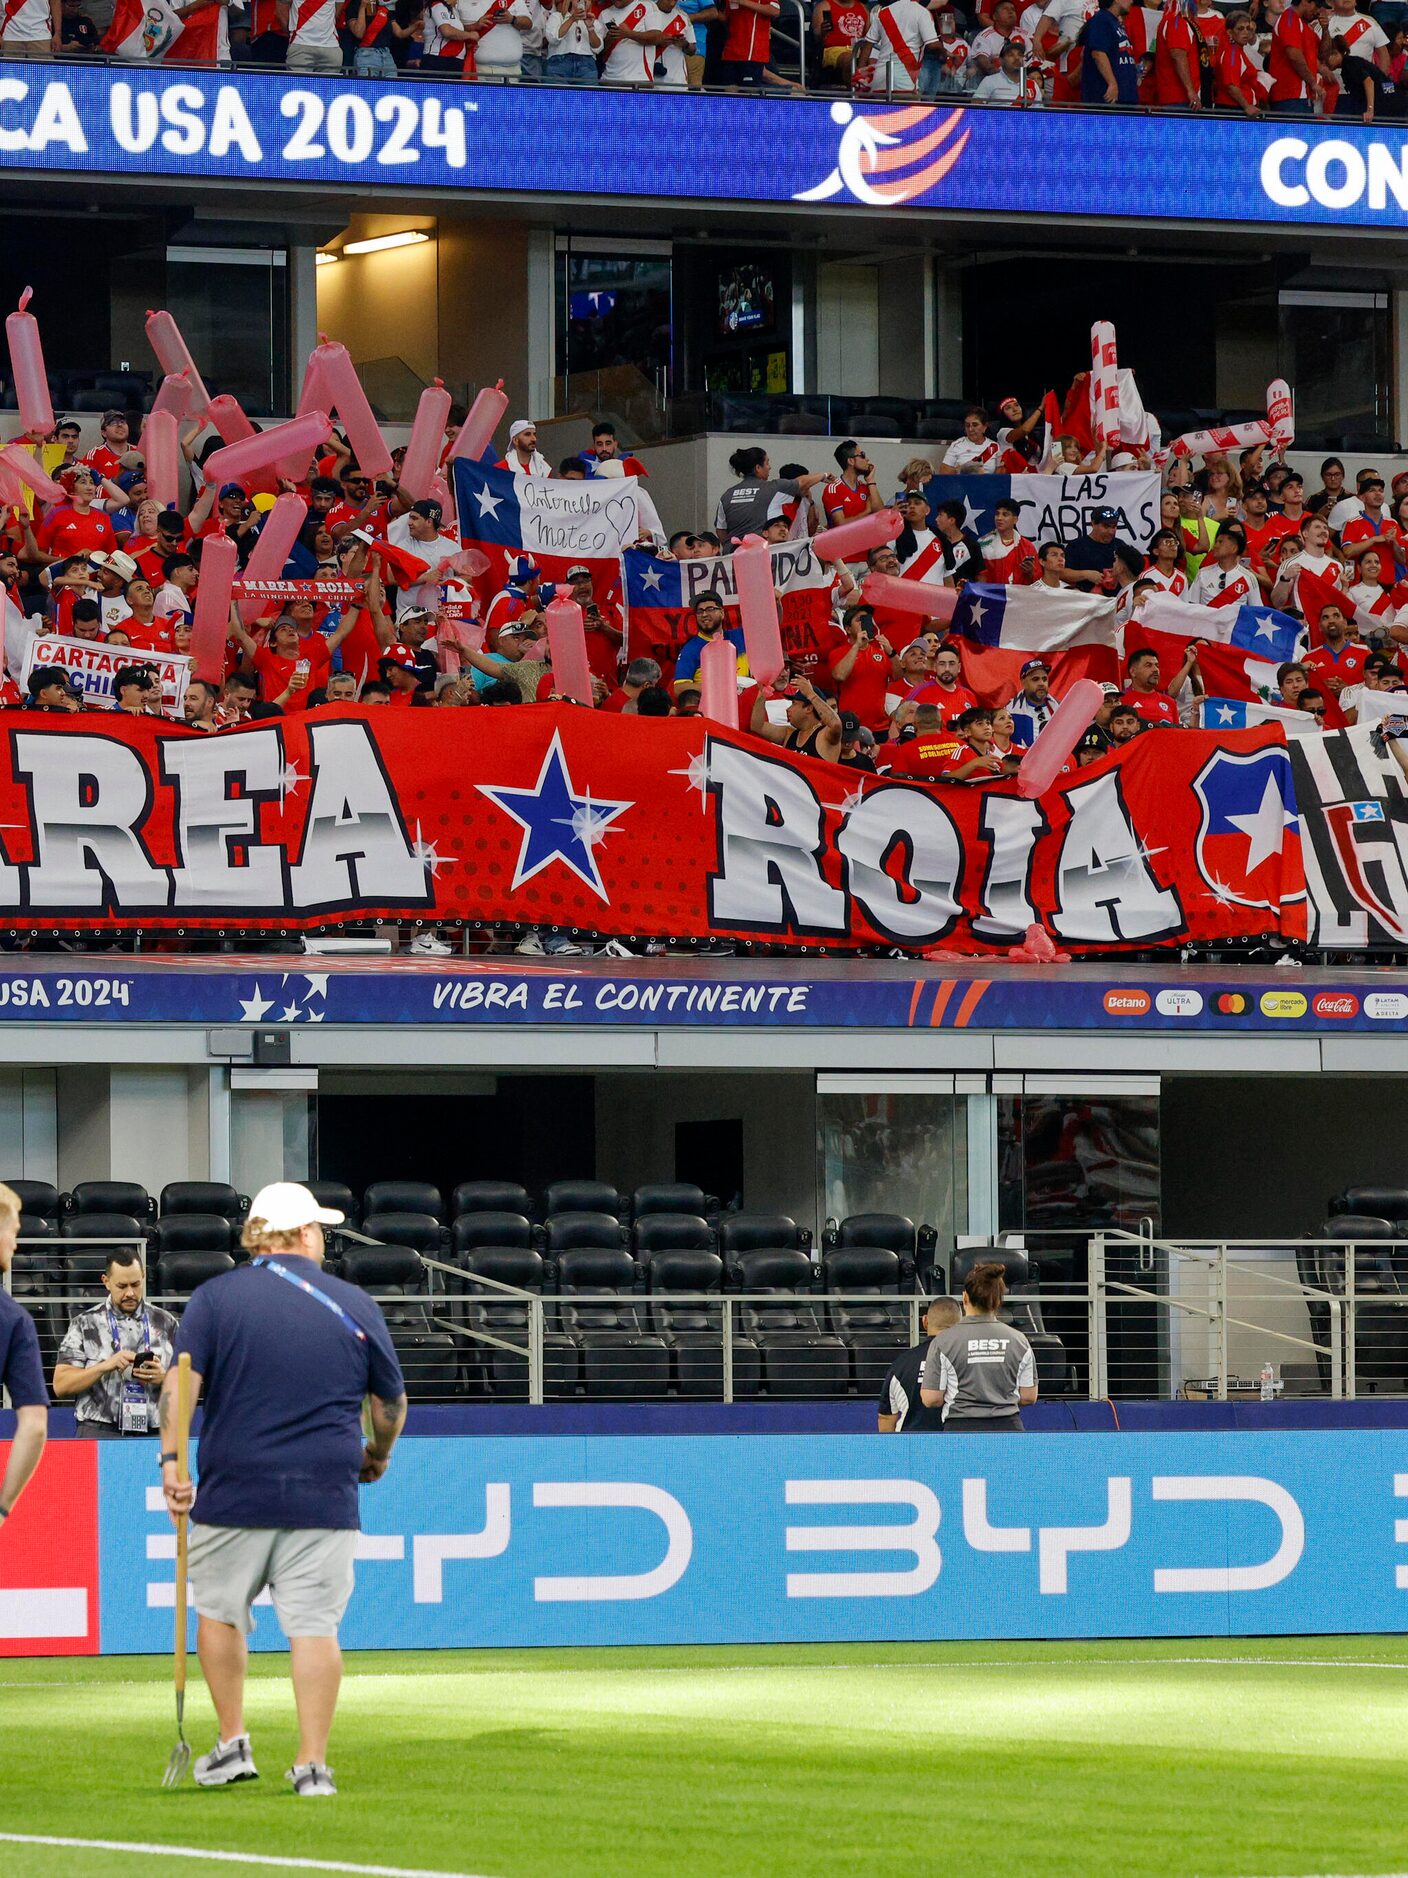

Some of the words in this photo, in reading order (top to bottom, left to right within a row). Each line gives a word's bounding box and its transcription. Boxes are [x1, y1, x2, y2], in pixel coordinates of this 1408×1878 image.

[110, 83, 263, 163] USA
[281, 90, 467, 169] 2024
[1260, 137, 1408, 211] CON
[732, 487, 760, 497] BEST
[1060, 474, 1109, 502] LAS
[244, 580, 298, 592] MAREA
[315, 581, 355, 593] ROJA
[706, 734, 1192, 943] ROJA
[56, 979, 129, 1006] 2024
[433, 981, 528, 1010] VIBRA
[542, 983, 583, 1010] EL
[595, 983, 811, 1012] CONTINENTE
[1107, 996, 1147, 1008] Betano
[1166, 997, 1192, 1005] ULTRA
[967, 1338, 1010, 1352] BEST
[785, 1476, 1305, 1598] BYD
